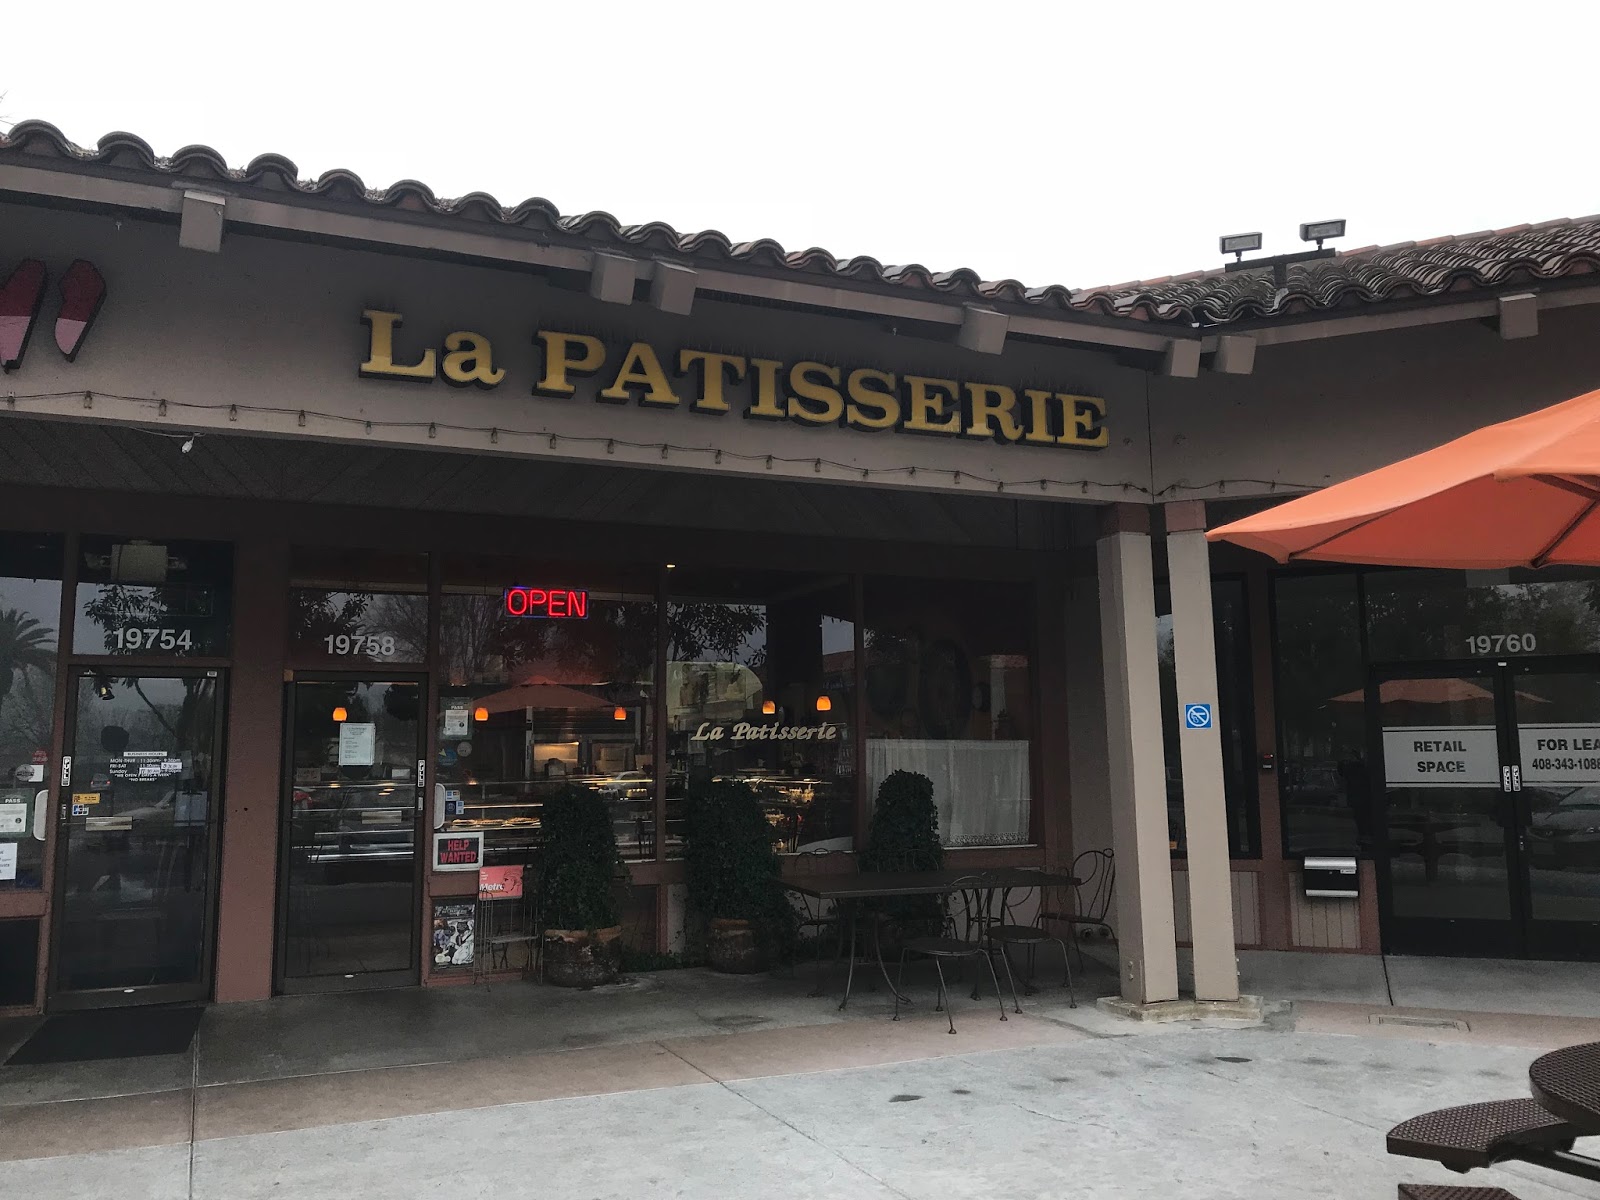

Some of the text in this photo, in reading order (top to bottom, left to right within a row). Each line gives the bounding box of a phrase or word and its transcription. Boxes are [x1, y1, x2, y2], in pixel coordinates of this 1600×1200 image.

[359, 308, 1110, 450] La PATISSERIE
[507, 588, 587, 618] OPEN
[112, 628, 193, 651] 19754
[323, 634, 396, 656] 19758
[1466, 632, 1537, 654] 19760
[690, 721, 837, 741] La Patisserie
[1413, 740, 1467, 753] RETAIL
[1537, 738, 1600, 751] FOR LEA
[1417, 760, 1466, 773] SPACE
[447, 839, 470, 852] HELP
[440, 851, 477, 863] WANTED
